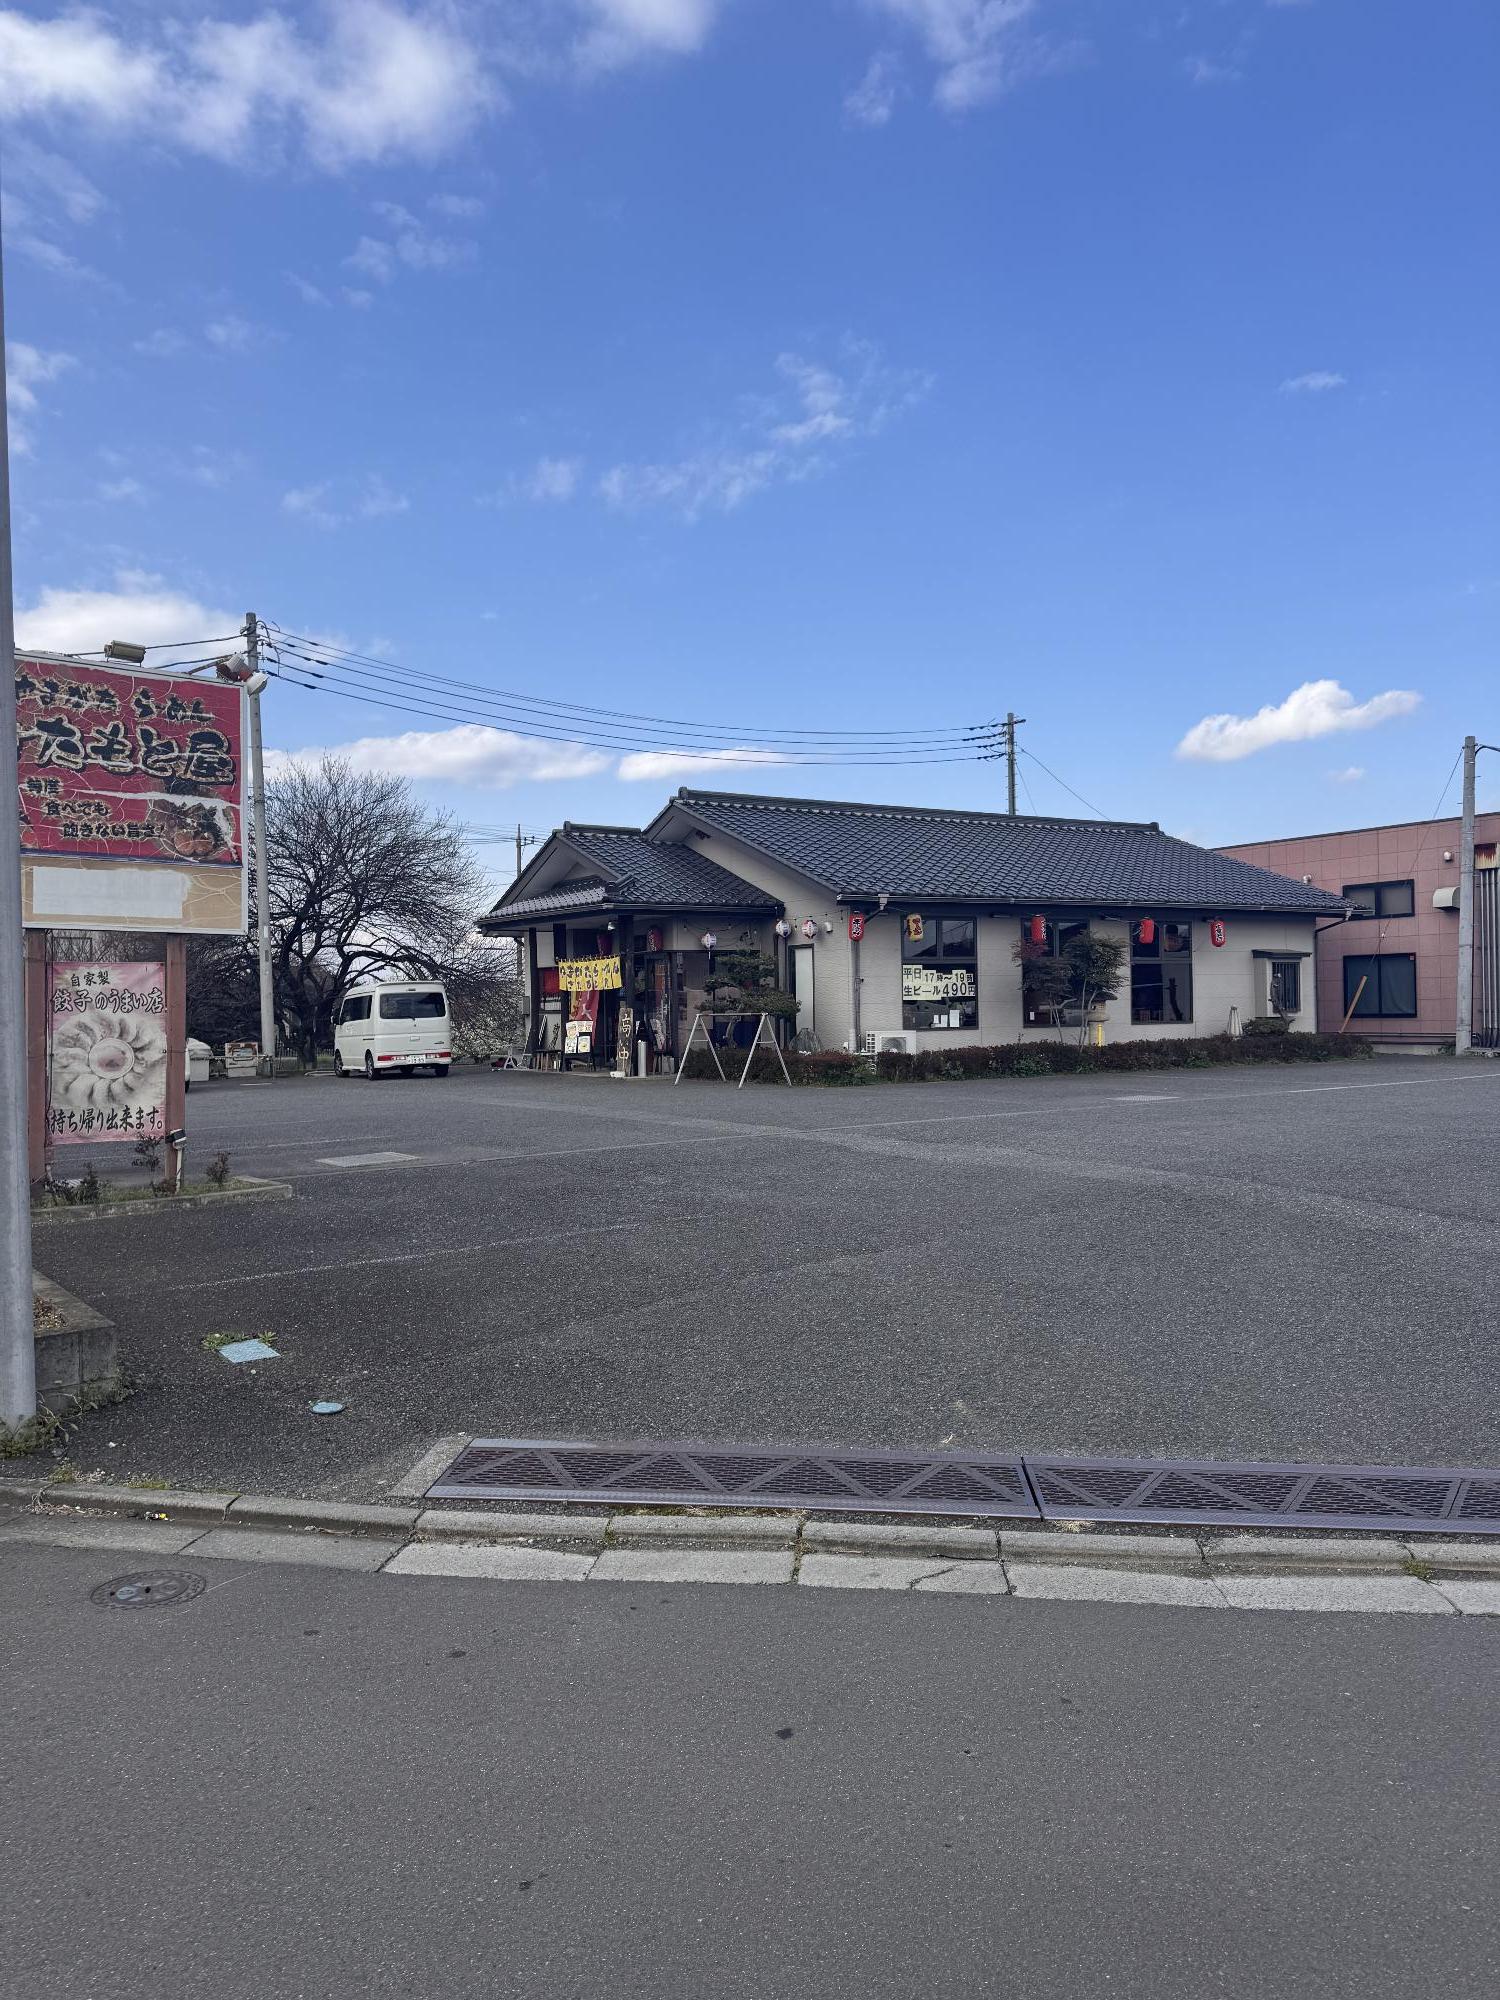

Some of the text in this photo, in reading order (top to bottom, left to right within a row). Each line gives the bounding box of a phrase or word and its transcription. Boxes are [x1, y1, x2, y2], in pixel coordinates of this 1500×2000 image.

[45, 800, 109, 816] 食べても
[70, 971, 110, 987] 自家製
[50, 1106, 164, 1135] 持ち帰り出来ます。
